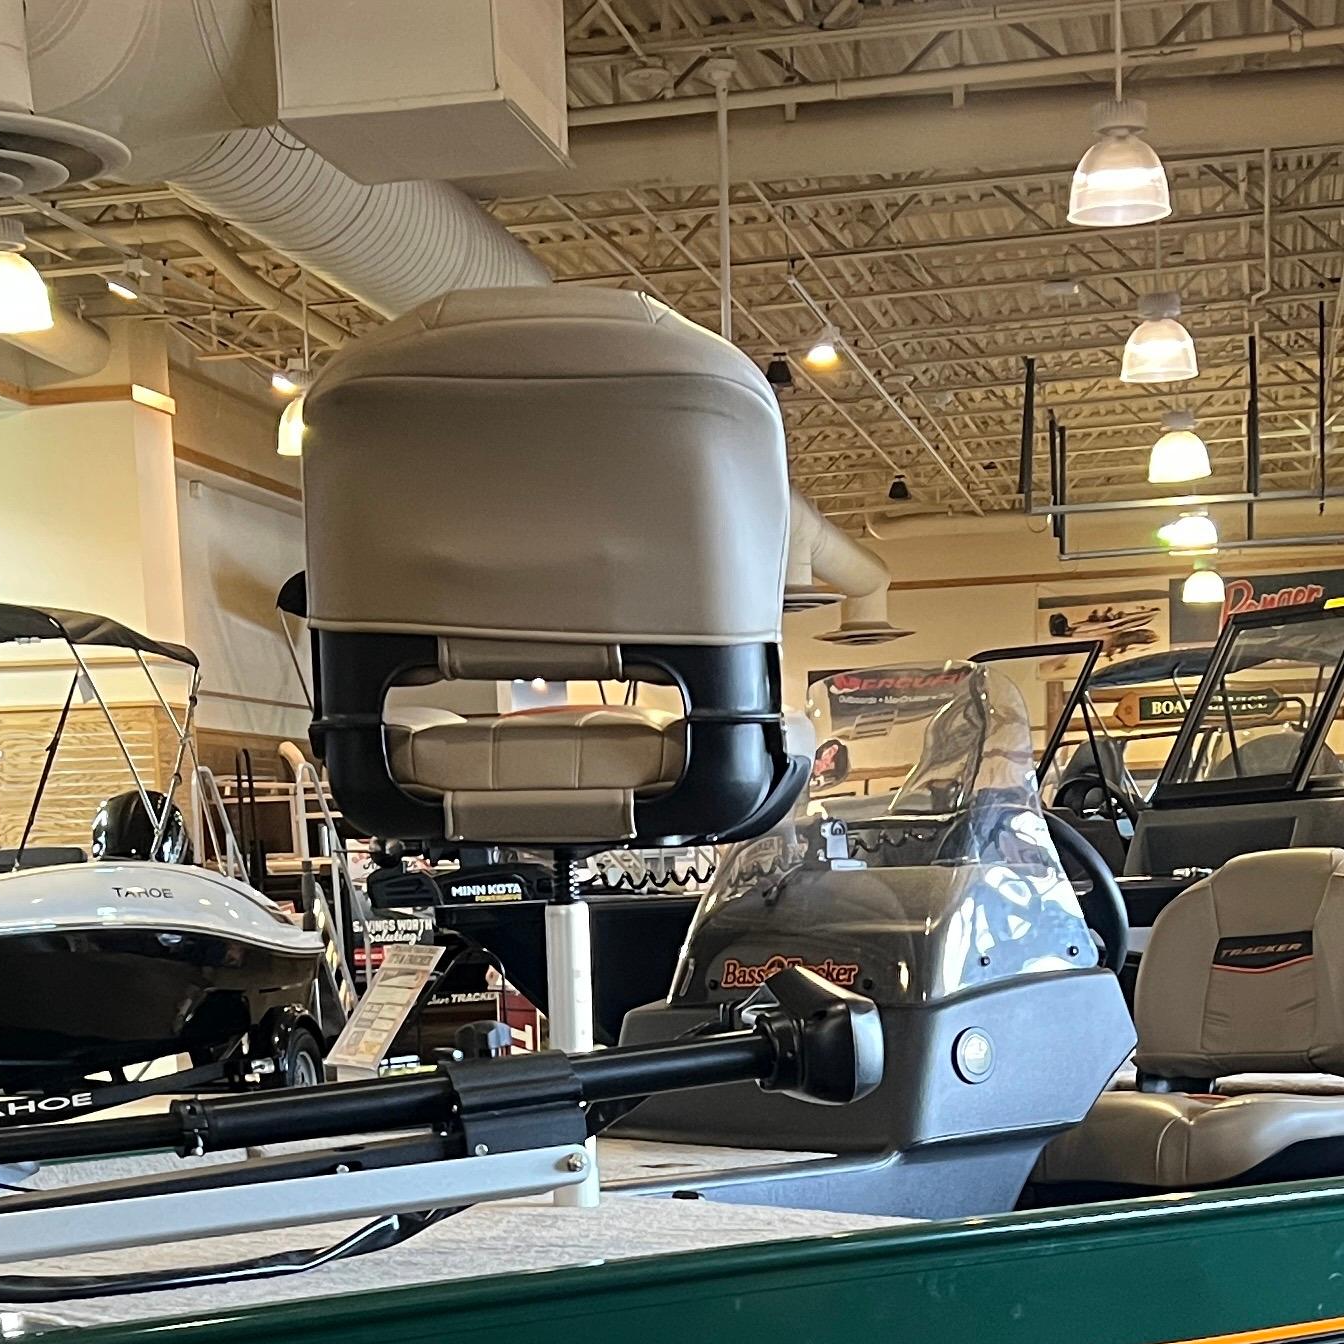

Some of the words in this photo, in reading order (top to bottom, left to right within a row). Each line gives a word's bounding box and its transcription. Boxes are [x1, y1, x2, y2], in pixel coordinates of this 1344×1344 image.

[396, 918, 433, 931] WORTH
[1220, 942, 1303, 959] TRACKER
[720, 959, 766, 988] Bass
